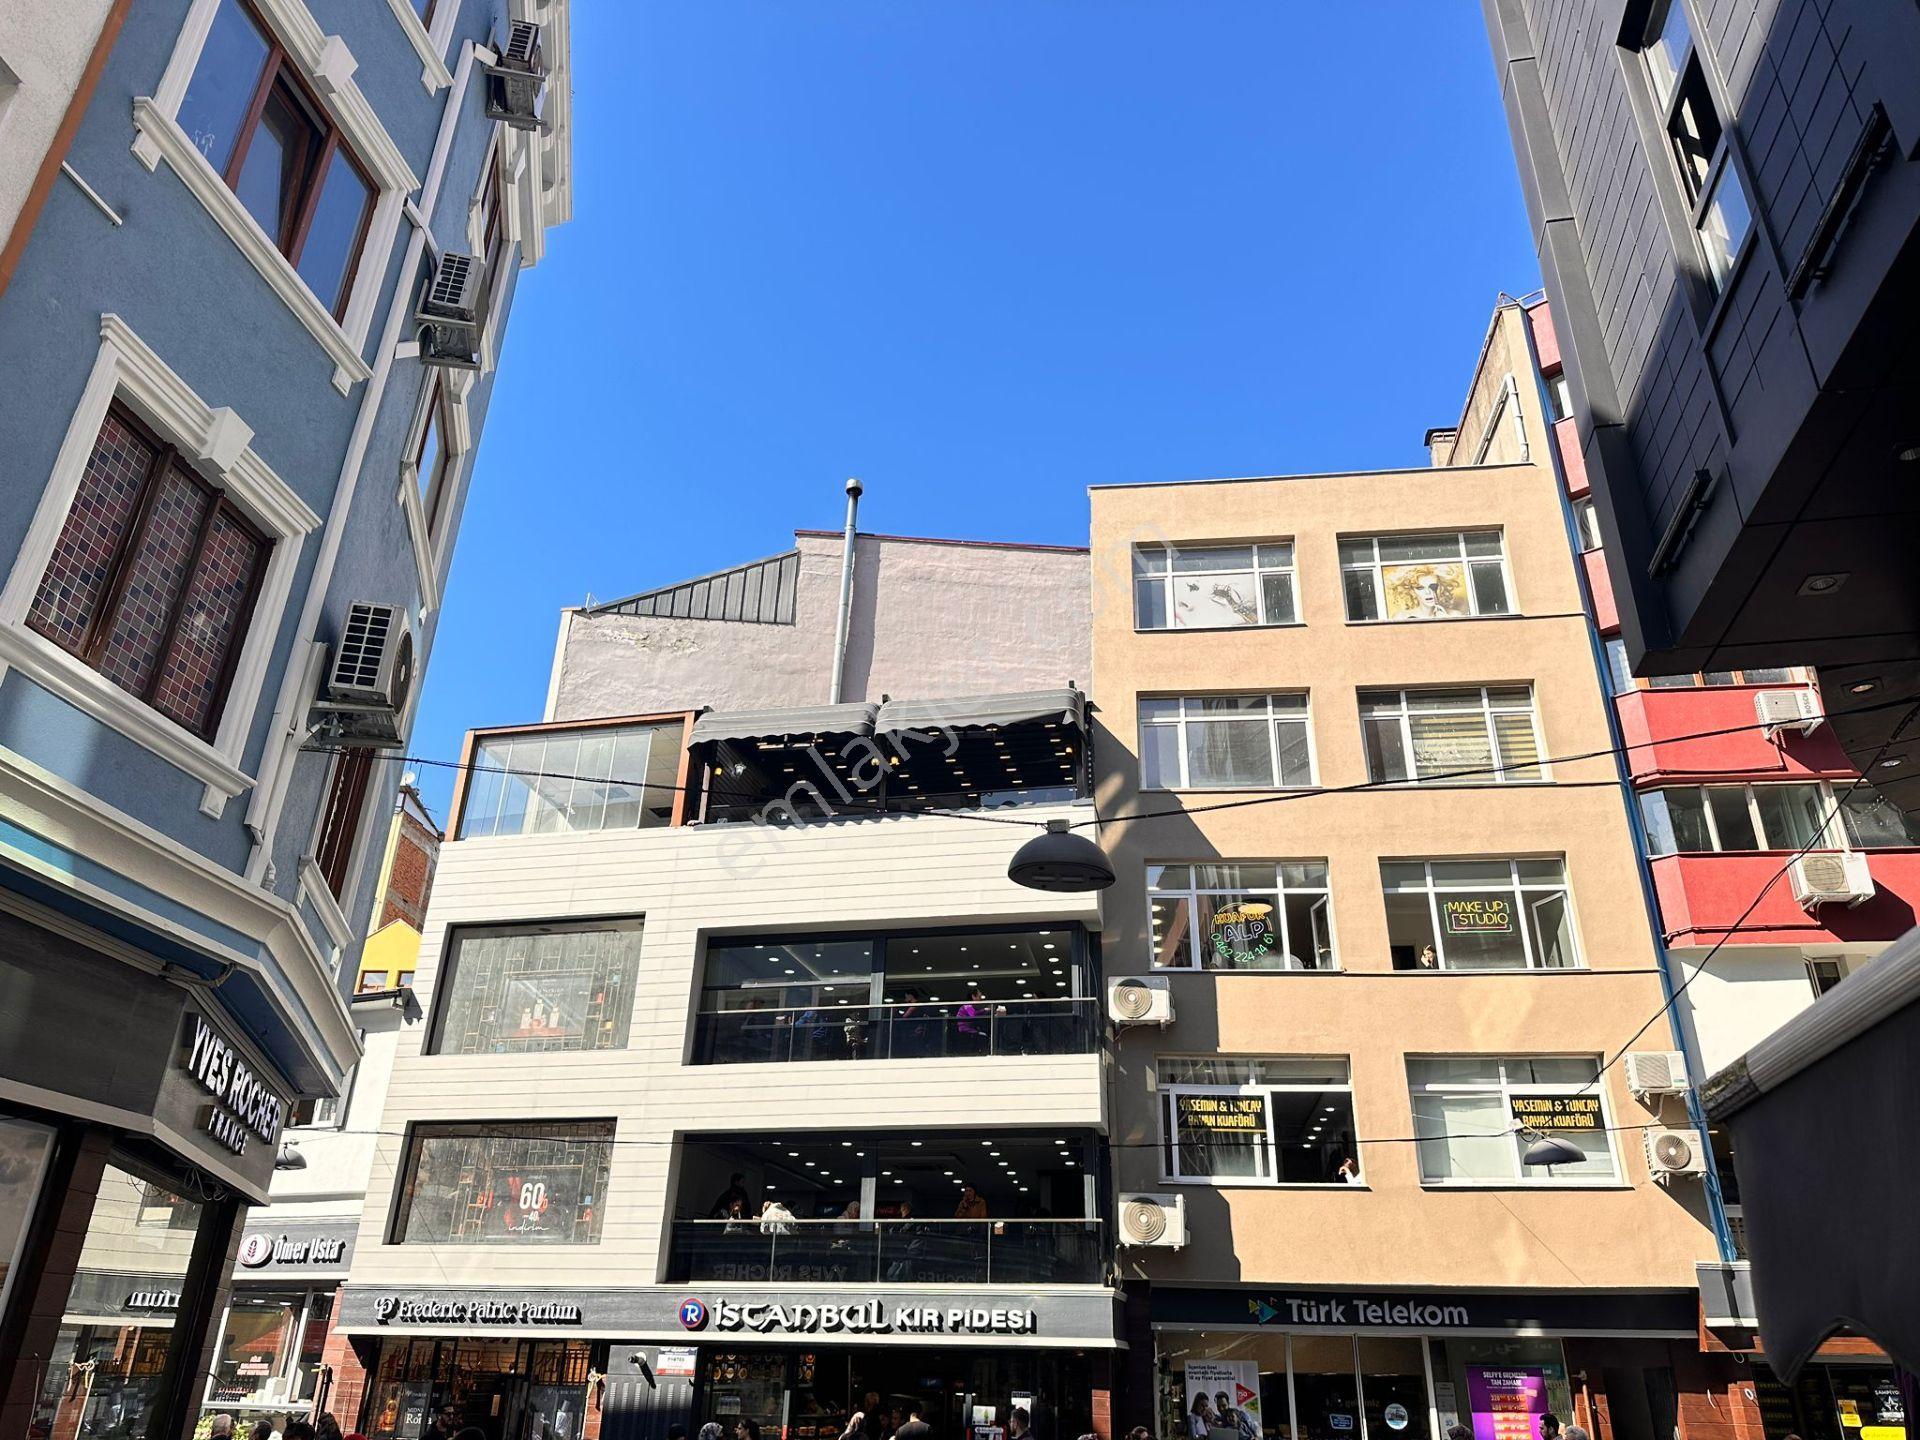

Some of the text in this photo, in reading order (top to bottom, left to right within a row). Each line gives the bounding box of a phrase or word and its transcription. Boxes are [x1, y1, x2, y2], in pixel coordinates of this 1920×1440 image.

[1448, 901, 1504, 913] MAKE UP
[1459, 913, 1508, 925] STUDIO
[1224, 921, 1264, 942] ALP
[1211, 933, 1233, 959] 0462
[1234, 951, 1255, 962] 224
[1255, 944, 1268, 956] 14
[188, 1015, 281, 1145] YVES ROCHER
[1219, 1101, 1227, 1112] &
[1554, 1101, 1563, 1112] &
[1563, 1099, 1598, 1112] TUNCAY
[1188, 1113, 1255, 1127] BAYAN KUAFÖRÜ
[1522, 1113, 1594, 1126] BAYAN KUAFÖRÜ
[208, 1107, 249, 1155] FRANCE
[272, 1234, 345, 1260] Ömer Usta
[400, 1300, 577, 1320] Frederic Patric Parfum
[896, 1307, 939, 1328] KIR
[947, 1308, 1031, 1329] PİDESİ
[1286, 1299, 1469, 1325] Türk Telekom
